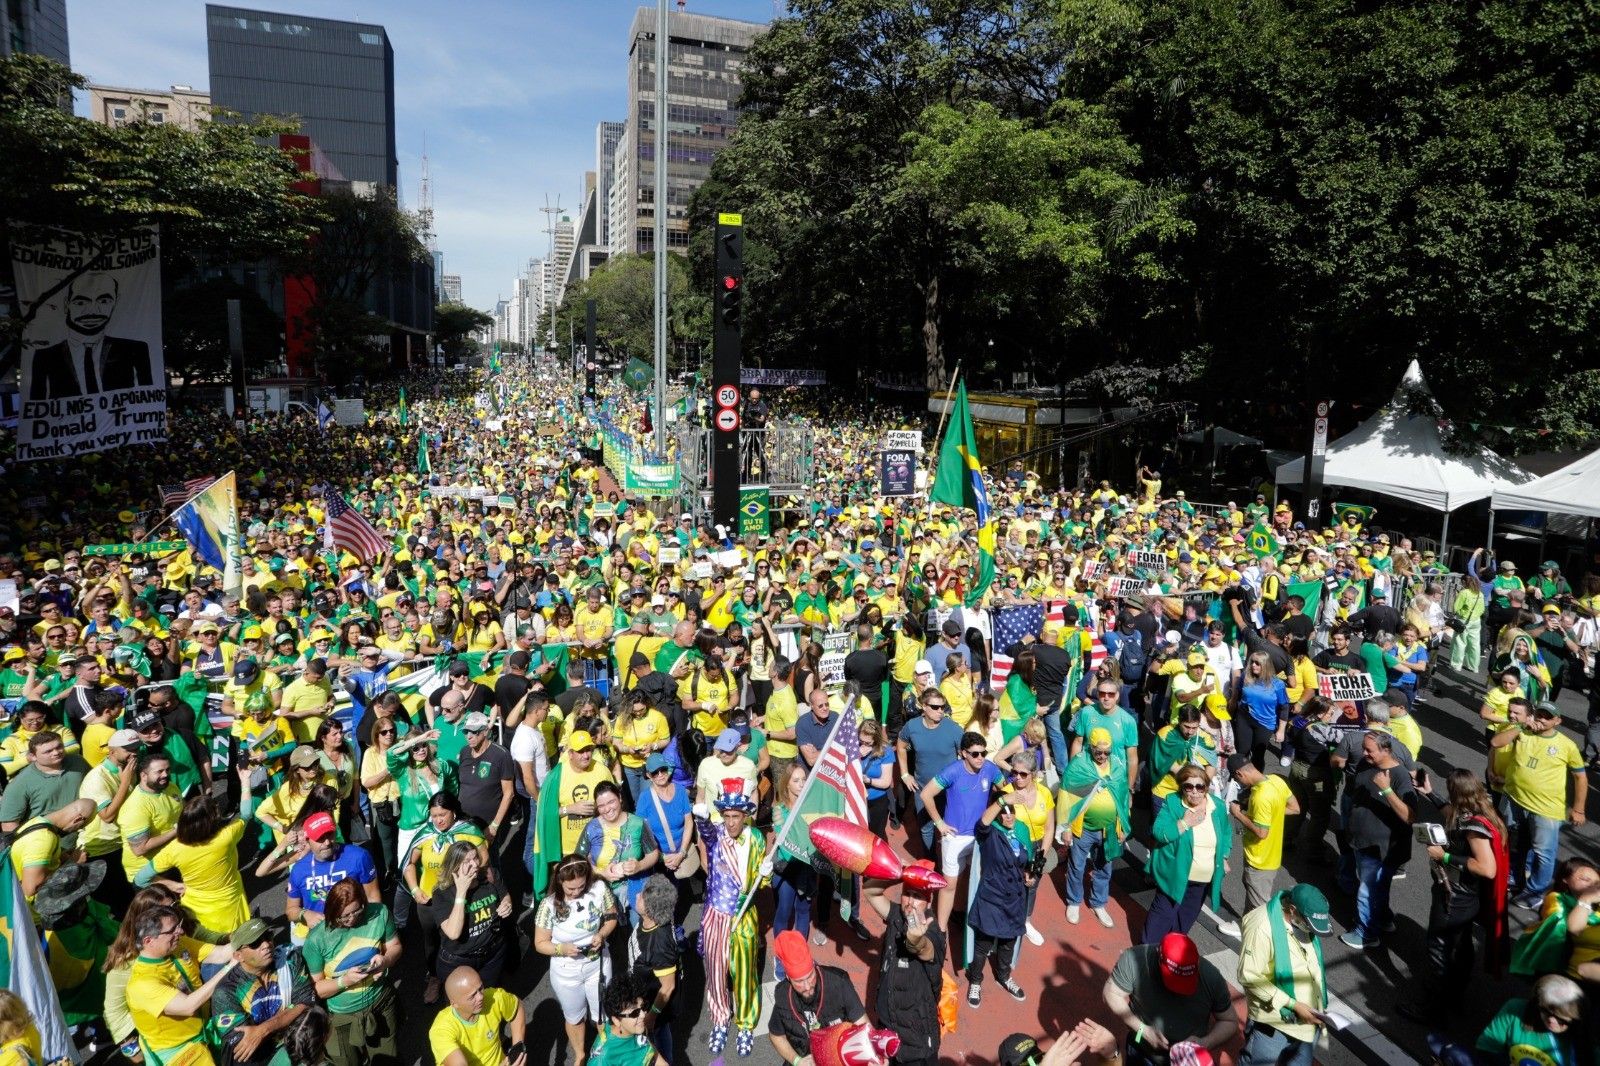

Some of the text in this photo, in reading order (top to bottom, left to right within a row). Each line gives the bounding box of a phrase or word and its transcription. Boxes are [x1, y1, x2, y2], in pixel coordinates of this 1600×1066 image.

[721, 390, 735, 400] 50
[99, 397, 107, 409] O
[33, 408, 165, 439] Donald Trump
[18, 440, 64, 459] Thank
[68, 440, 94, 456] you
[97, 430, 132, 446] very
[886, 454, 910, 462] FORA
[1137, 561, 1165, 571] MORAES
[820, 658, 845, 666] EREMO
[1334, 688, 1373, 700] MORAES
[1526, 755, 1539, 770] 10
[784, 841, 801, 855] VIVA
